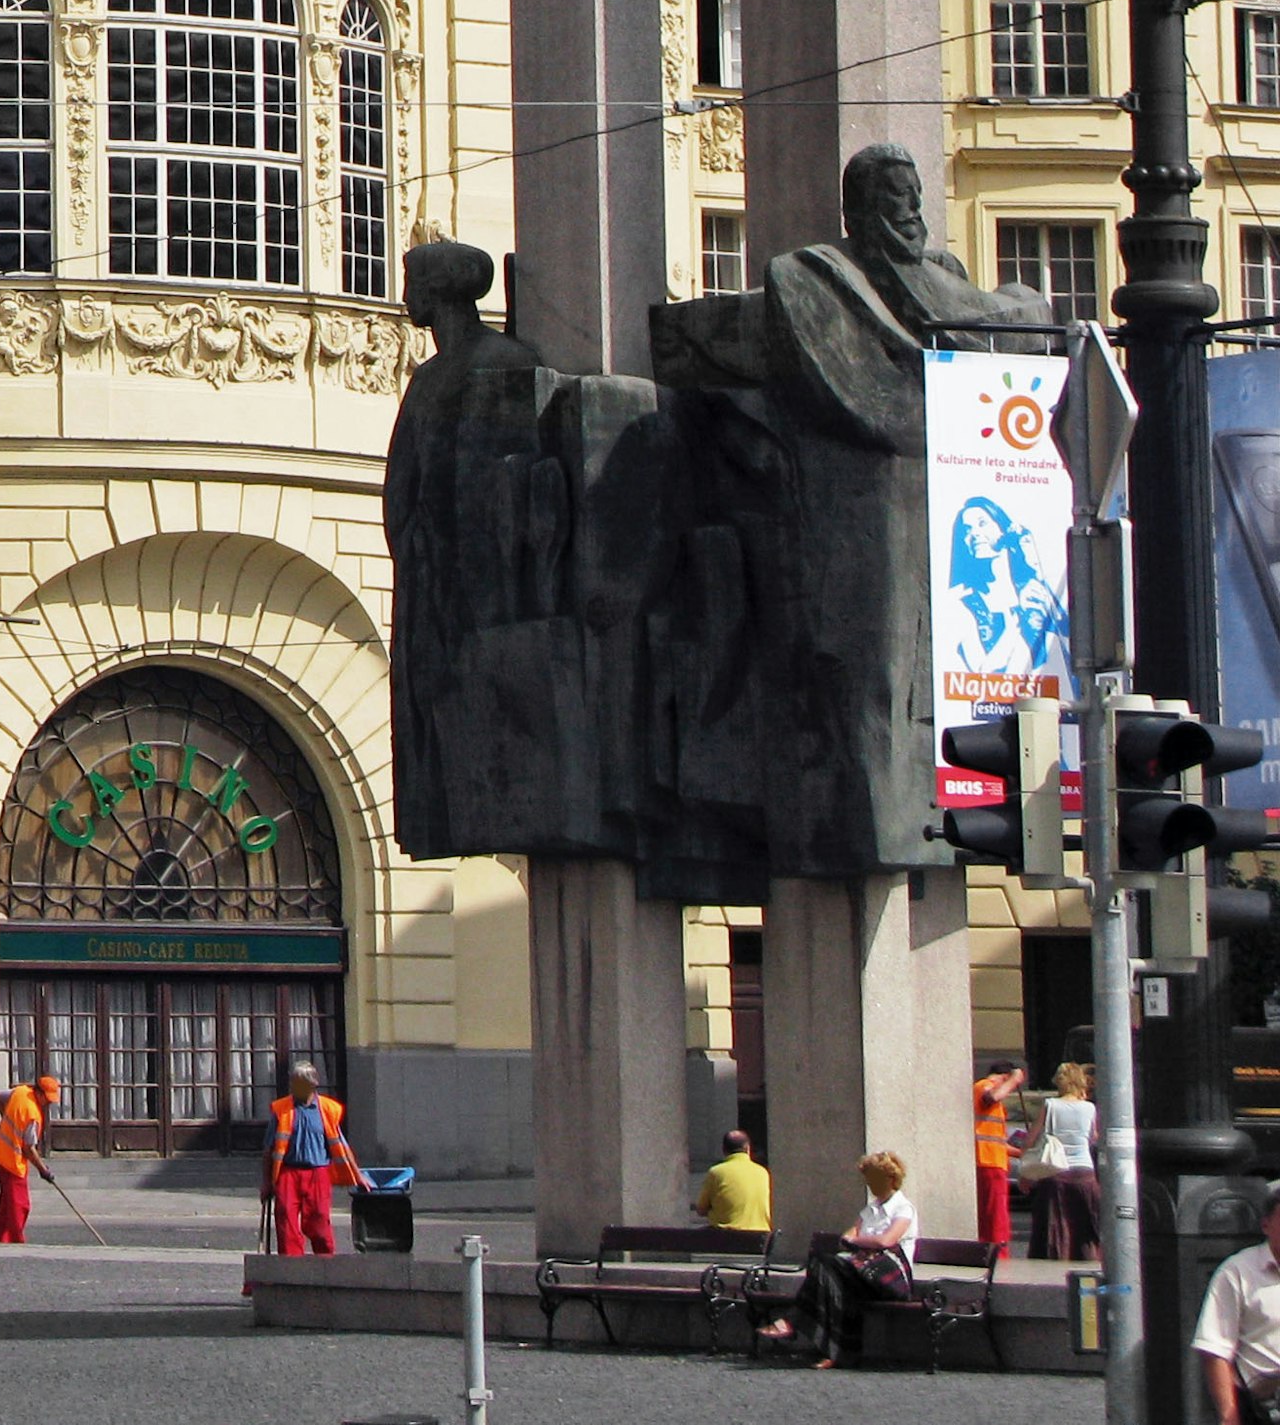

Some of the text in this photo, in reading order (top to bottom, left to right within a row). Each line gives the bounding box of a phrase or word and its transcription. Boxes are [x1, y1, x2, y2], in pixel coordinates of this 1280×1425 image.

[936, 453, 982, 465] Kultúrne
[985, 455, 1006, 467] leto
[1008, 459, 1015, 468] a
[1018, 457, 1058, 470] Hradné
[995, 472, 1049, 484] Bratislava
[949, 671, 1044, 700] Najväčší
[973, 702, 1013, 717] festiva
[945, 780, 983, 796] BKIS
[1060, 785, 1082, 795] BRA
[48, 743, 278, 853] CASINO
